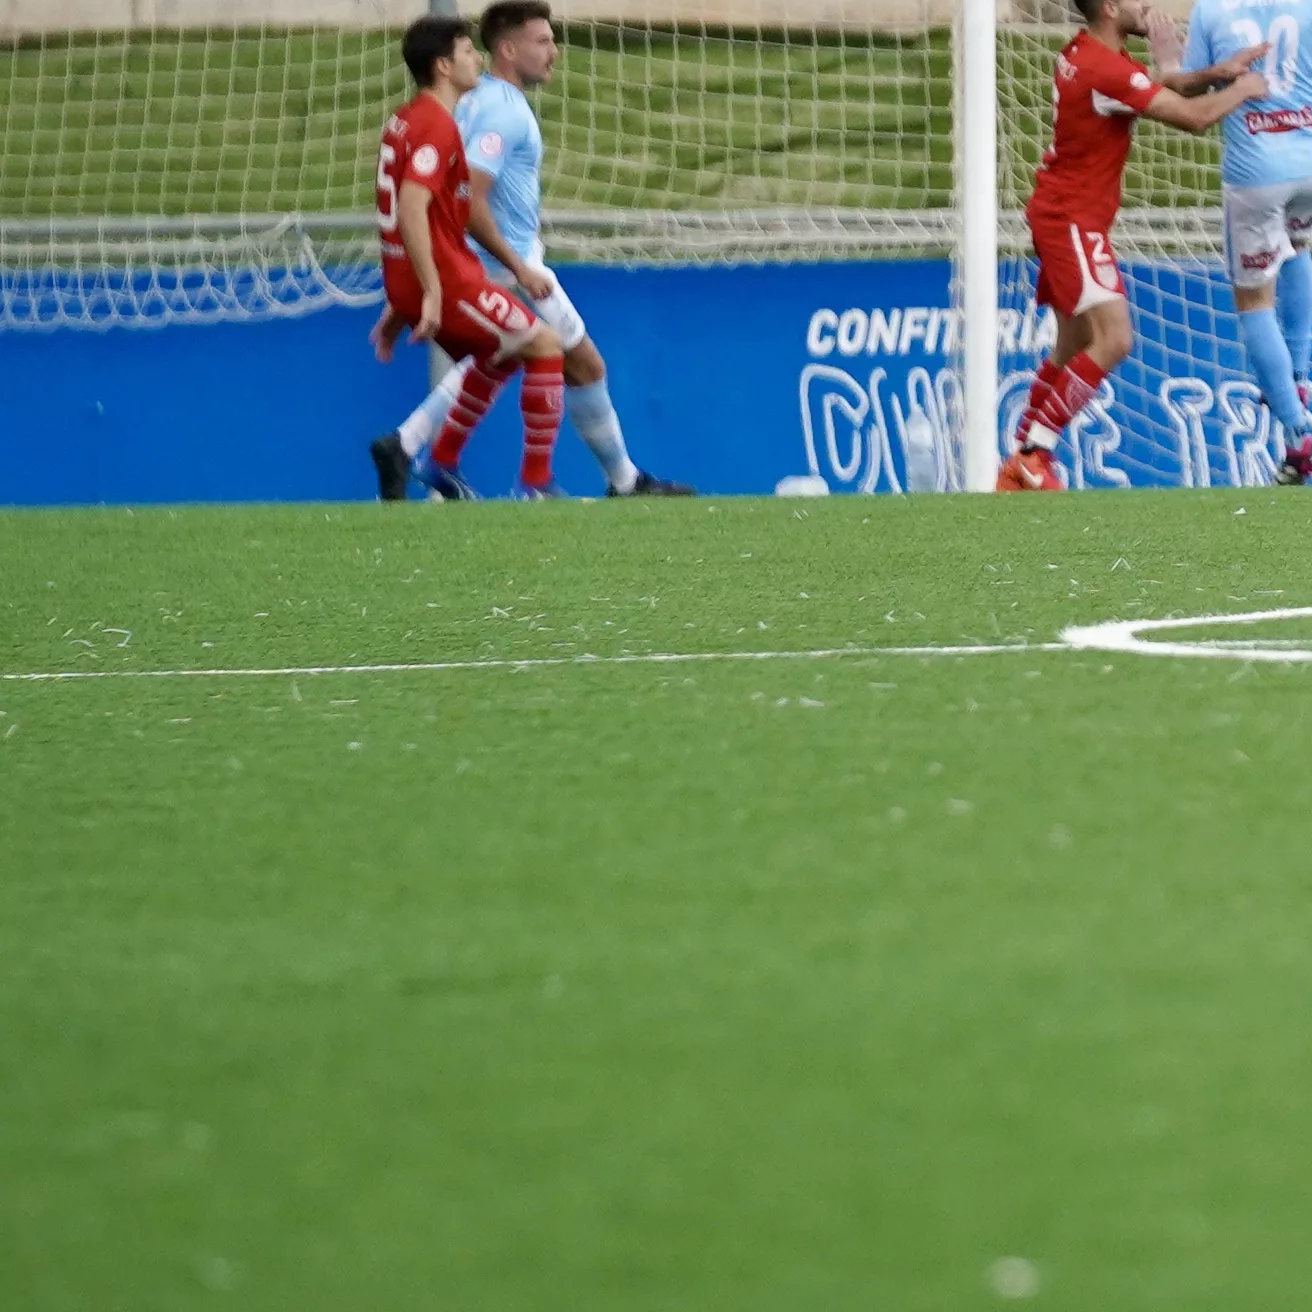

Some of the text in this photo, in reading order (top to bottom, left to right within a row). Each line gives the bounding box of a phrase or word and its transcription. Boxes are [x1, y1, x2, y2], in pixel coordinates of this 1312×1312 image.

[376, 141, 400, 231] 5
[1085, 231, 1111, 263] 2
[478, 290, 510, 323] 5
[807, 300, 1060, 357] CONFITRÍA
